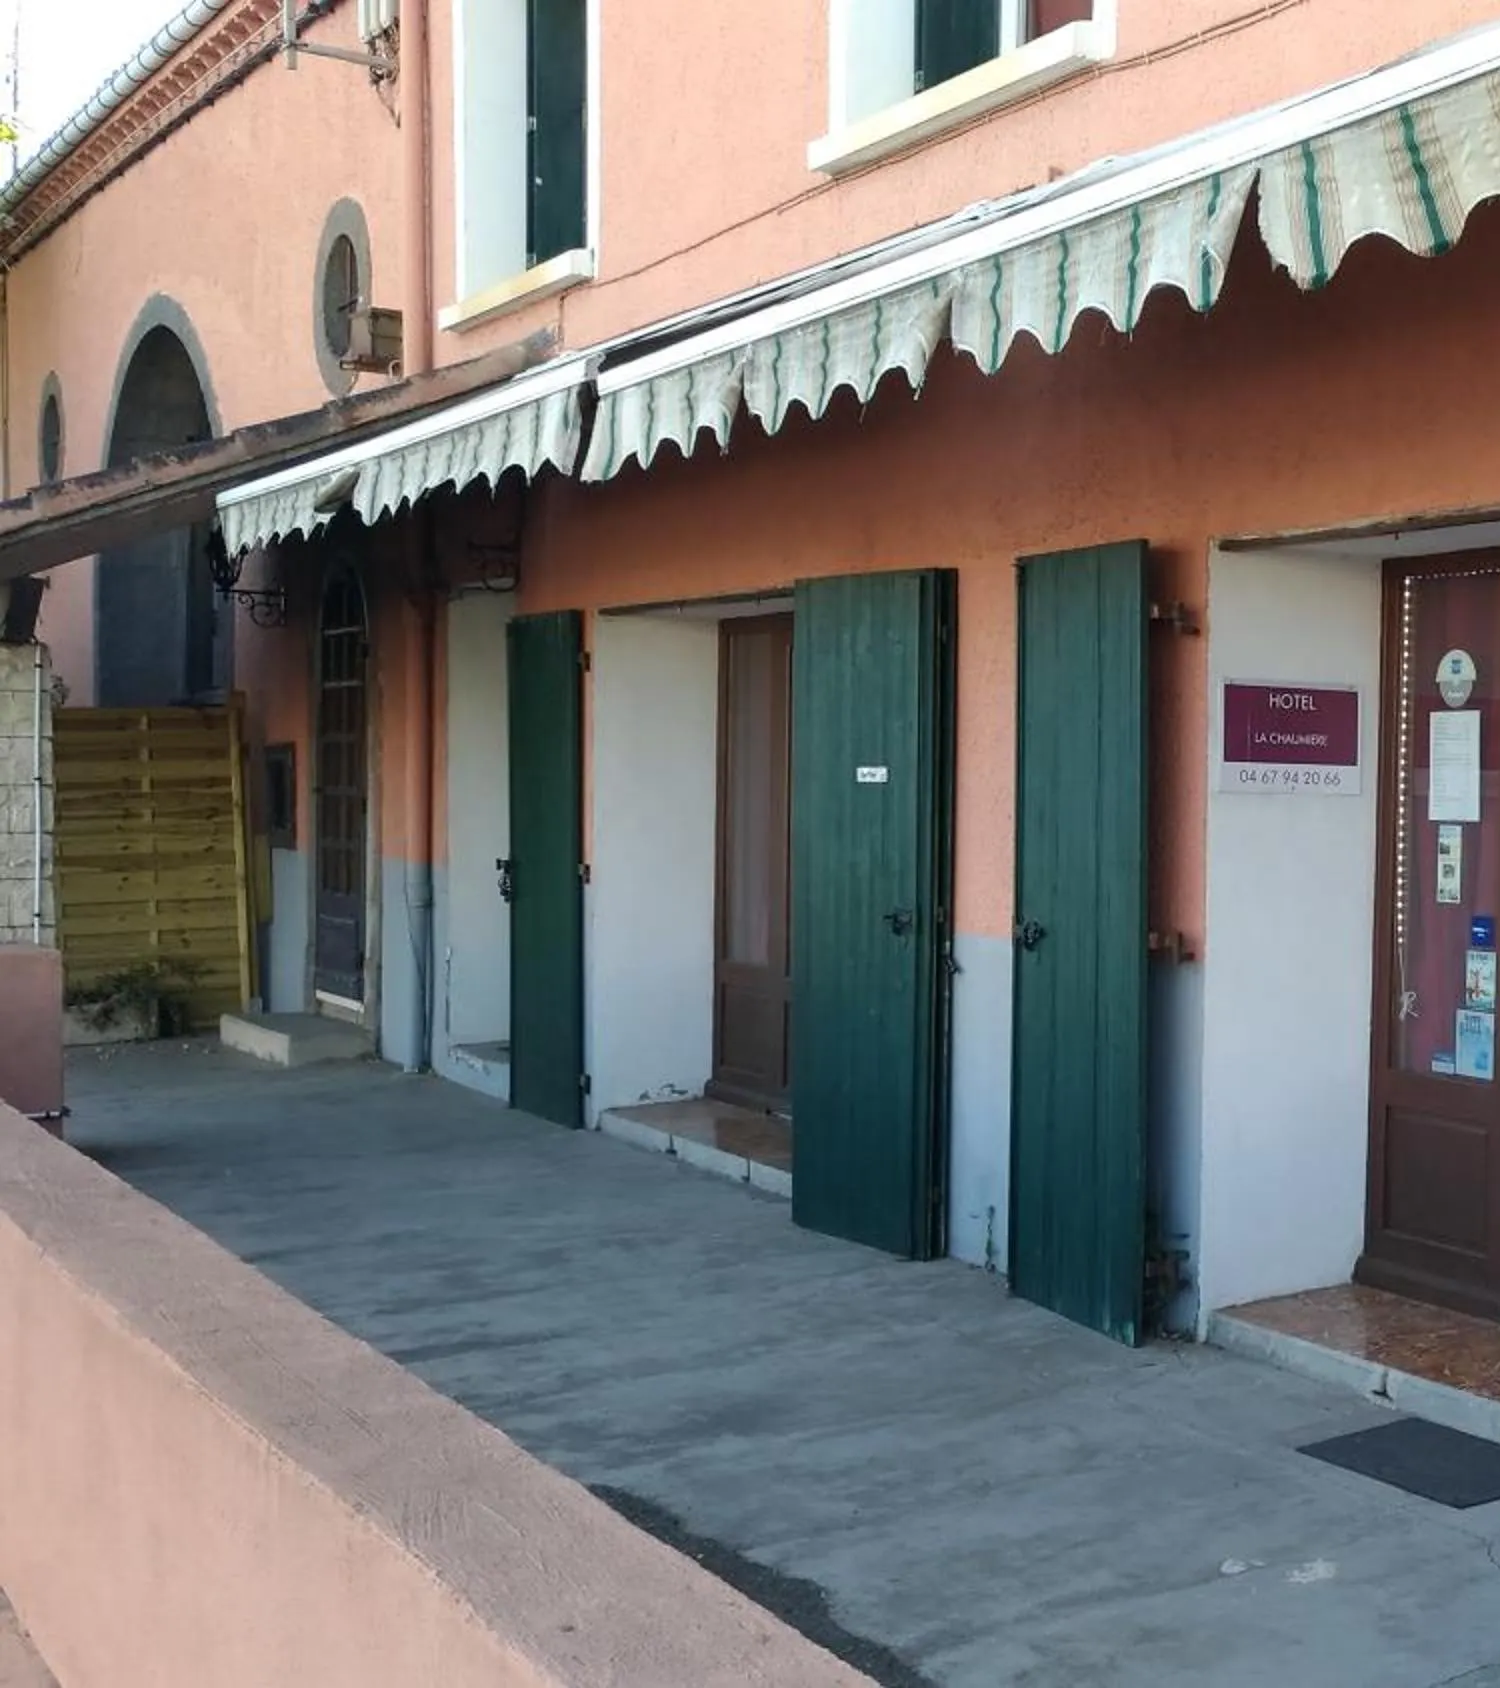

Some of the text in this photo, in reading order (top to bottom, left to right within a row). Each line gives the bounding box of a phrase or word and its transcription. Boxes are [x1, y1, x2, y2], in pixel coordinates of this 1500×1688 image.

[1269, 693, 1318, 711] HOTEL
[1255, 732, 1268, 743] LA
[1239, 769, 1341, 787] 04 67 94 20 66
